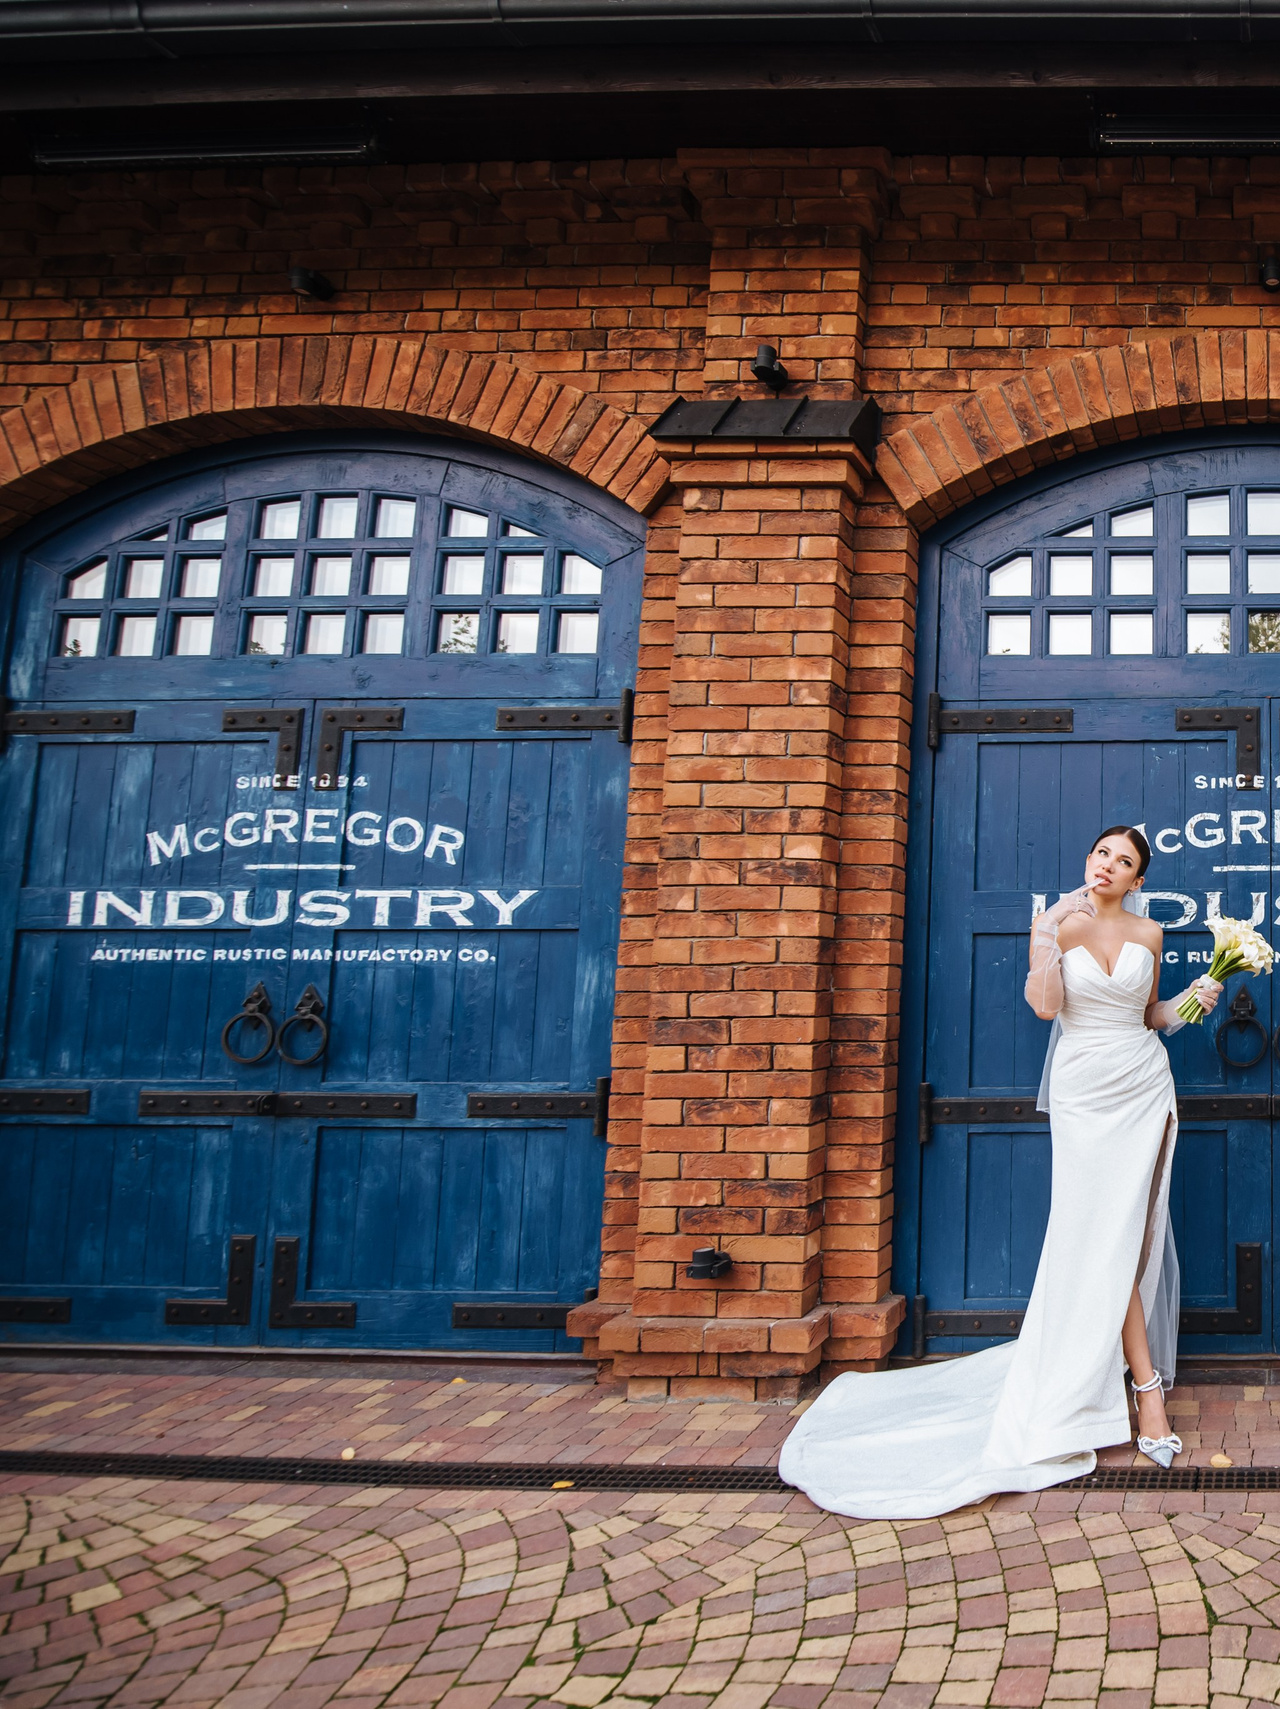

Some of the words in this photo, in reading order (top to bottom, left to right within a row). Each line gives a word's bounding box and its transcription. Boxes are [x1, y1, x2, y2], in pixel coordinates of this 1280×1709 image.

[235, 773, 301, 789] SINCE
[1194, 773, 1265, 789] SINCE
[146, 808, 465, 867] McGREGOR
[66, 889, 539, 927] INDUSTRY
[91, 948, 207, 962] AUTHENTIC
[213, 948, 287, 962] RUSTIC
[292, 948, 452, 962] MANUFACTORY
[458, 948, 496, 962] CO.
